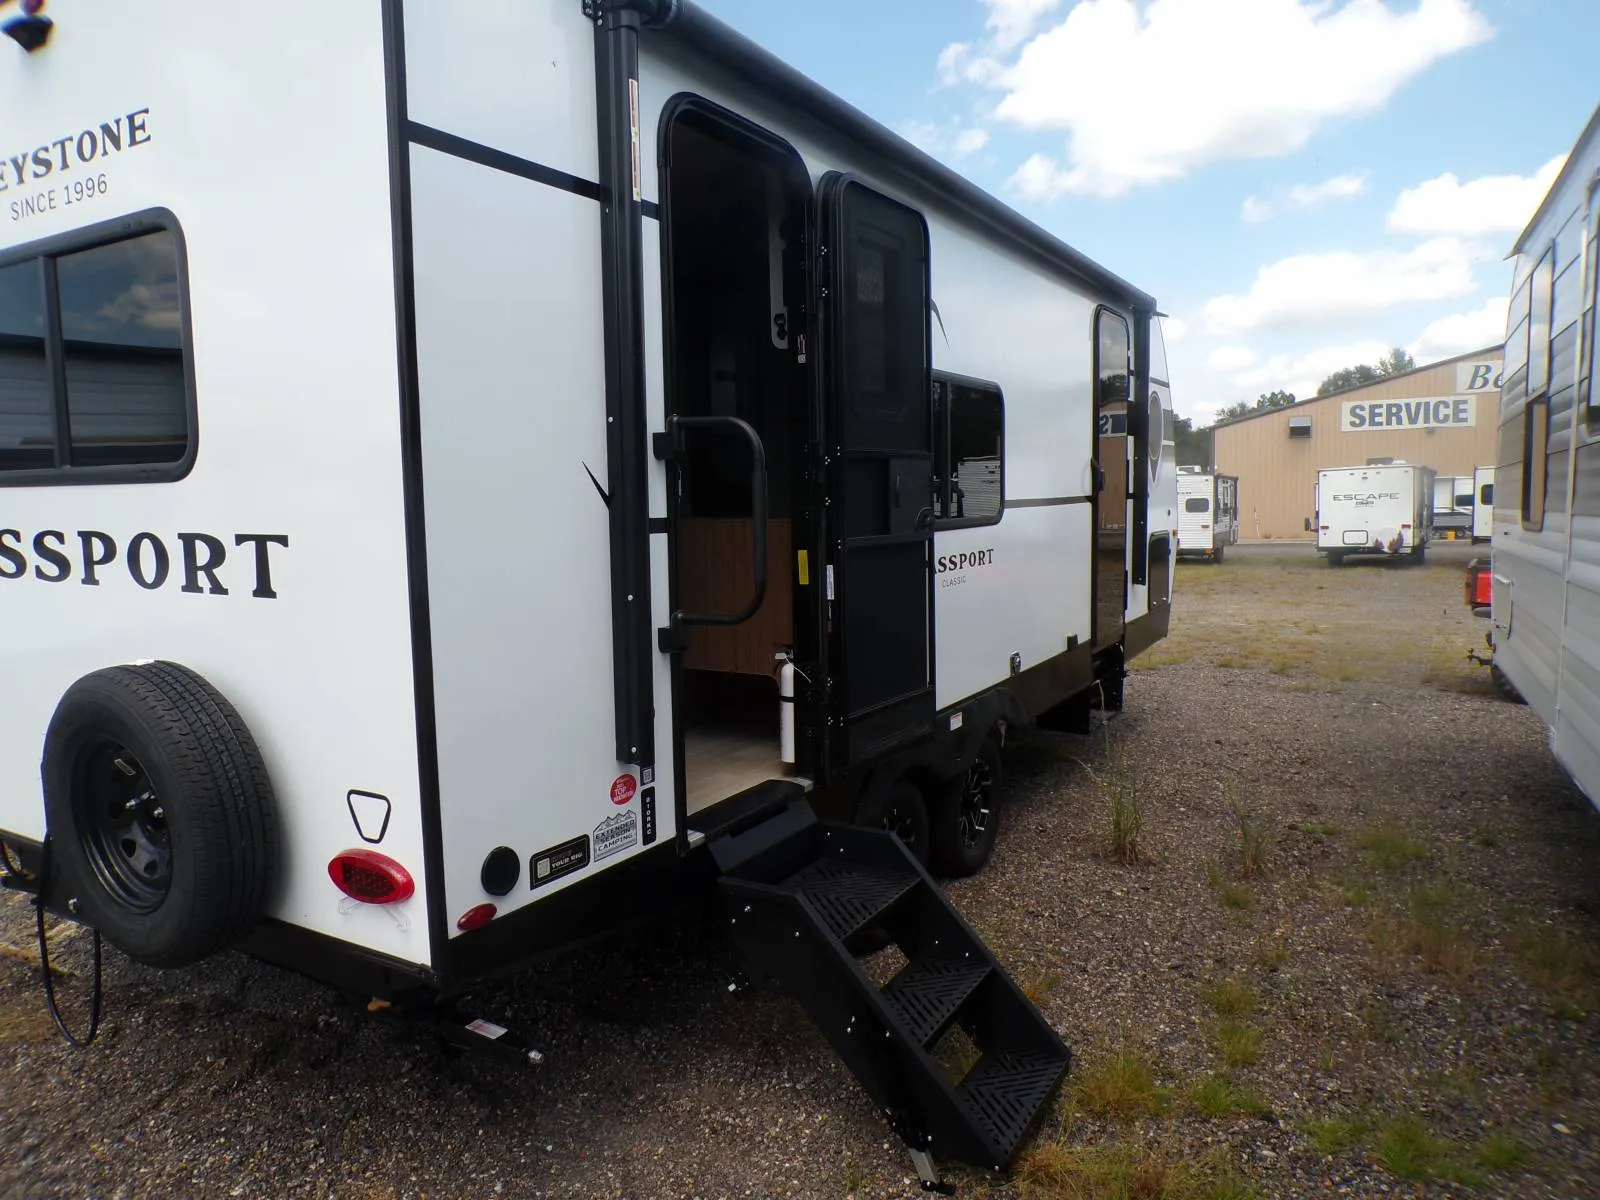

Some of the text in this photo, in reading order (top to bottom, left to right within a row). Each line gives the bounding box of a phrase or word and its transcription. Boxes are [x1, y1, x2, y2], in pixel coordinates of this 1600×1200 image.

[11, 173, 108, 221] SINCE 1996
[1349, 399, 1469, 428] SERVICE
[1333, 493, 1400, 501] ESCAPE
[0, 528, 289, 599] SSPORT
[933, 549, 994, 574] SSPORT
[942, 575, 967, 588] CLASSIC
[595, 819, 635, 840] EXTENDED
[600, 827, 631, 843] SEASON
[598, 832, 633, 852] CAMPING
[551, 857, 570, 869] YOUR
